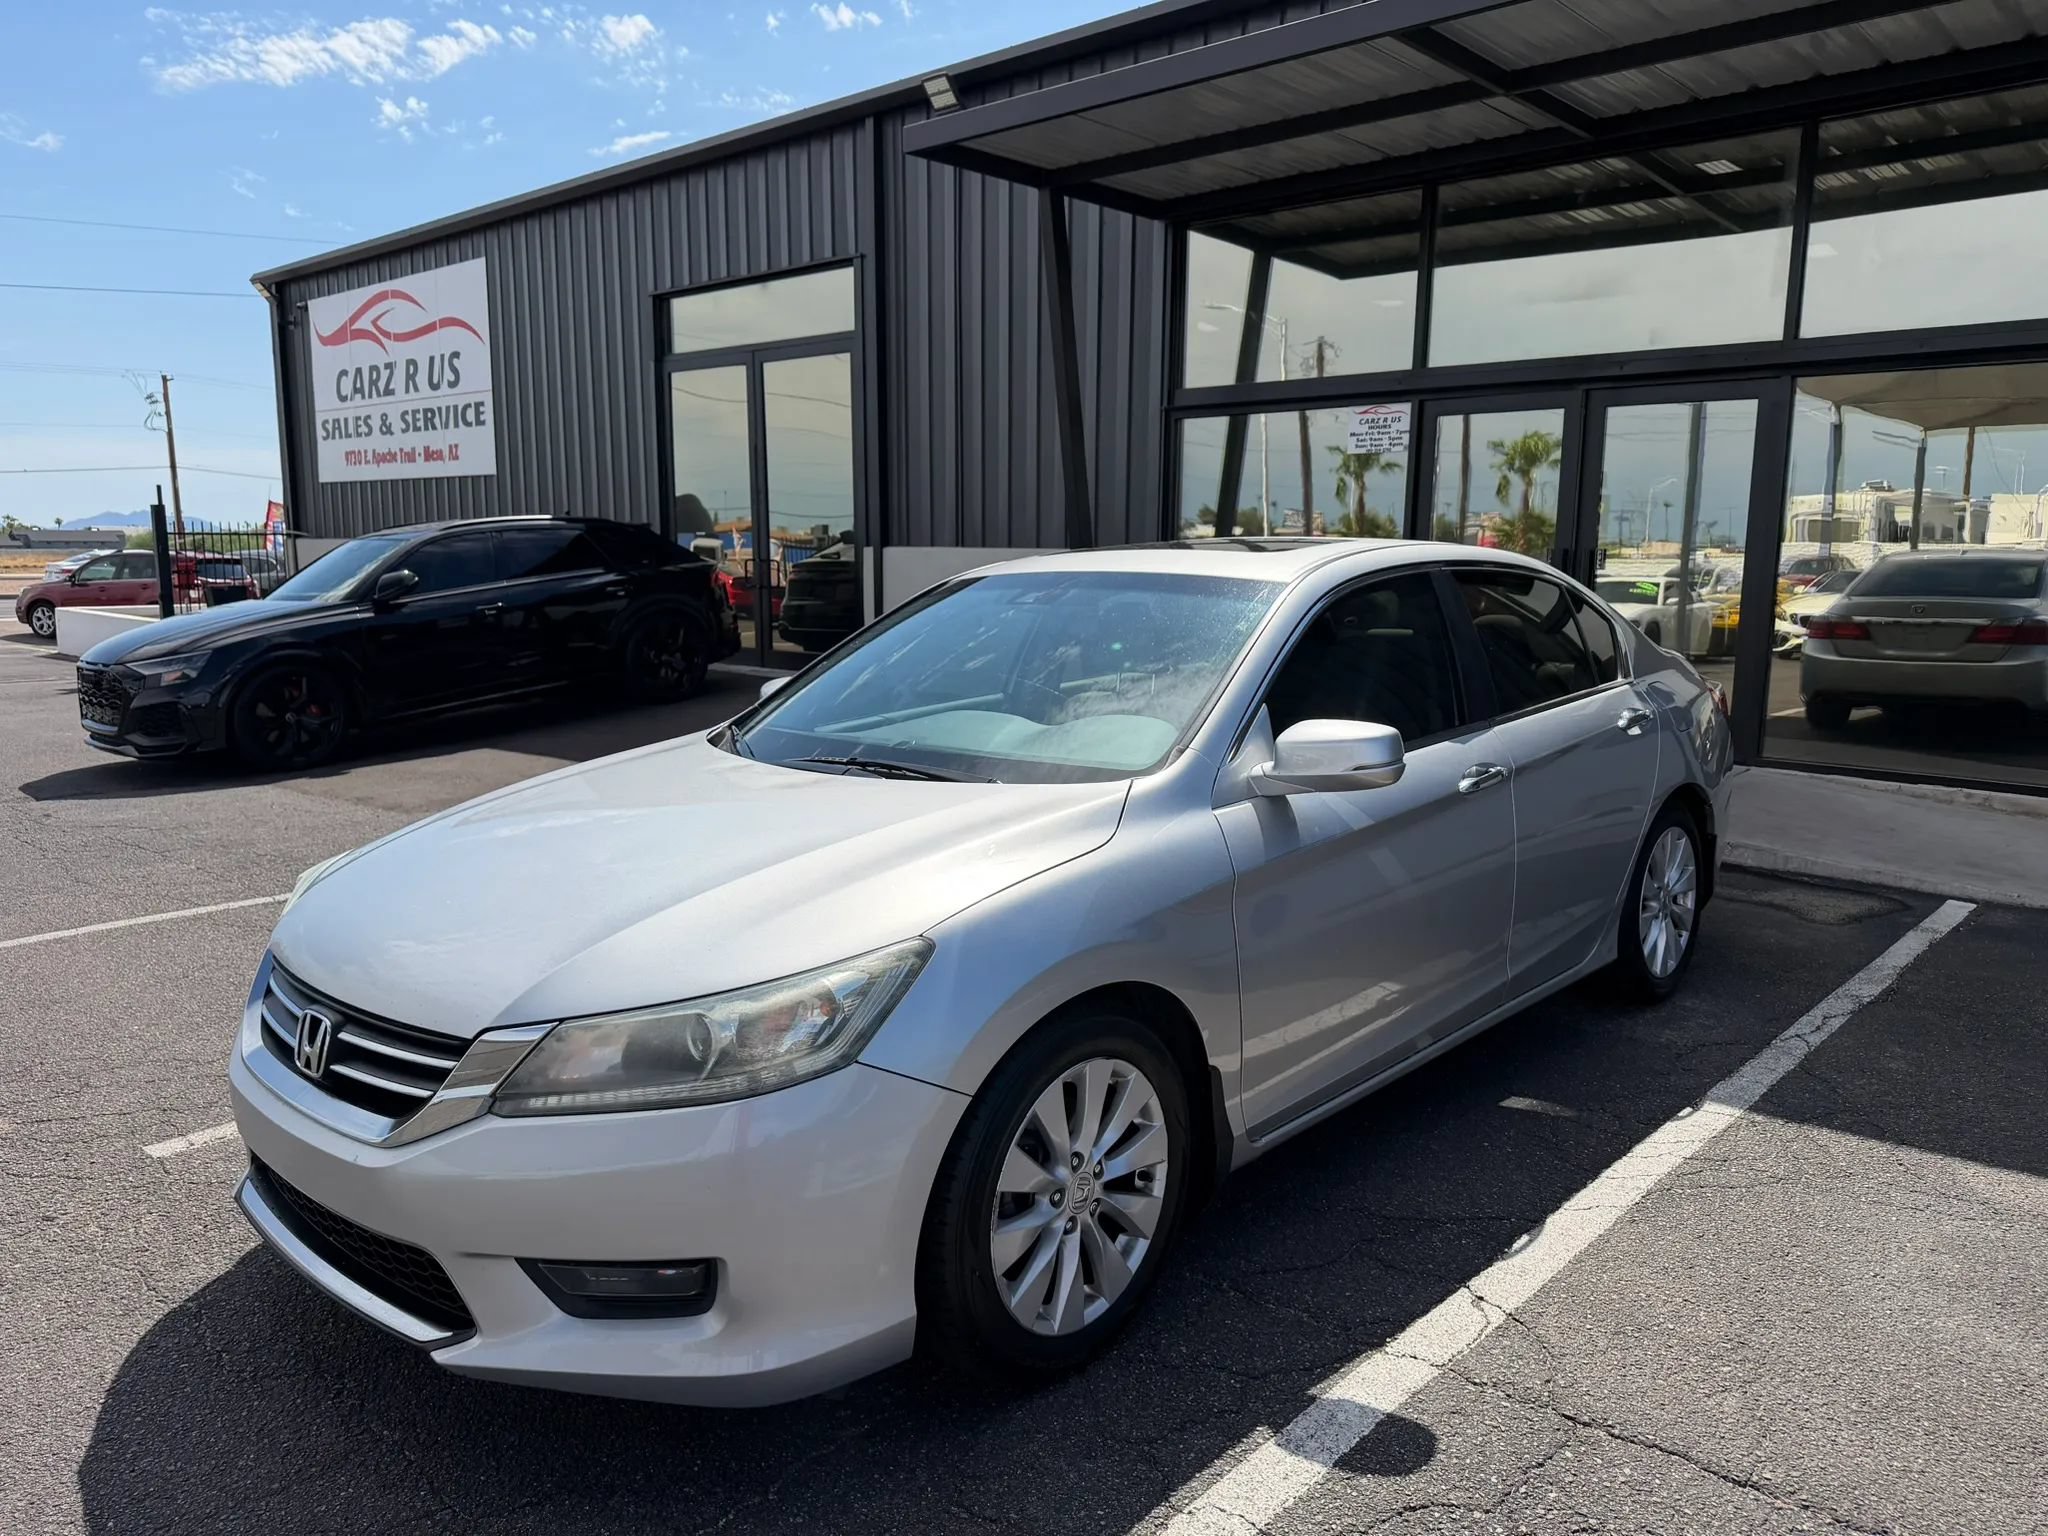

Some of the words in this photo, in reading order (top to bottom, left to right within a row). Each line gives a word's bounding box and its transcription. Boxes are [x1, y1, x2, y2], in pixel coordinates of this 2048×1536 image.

[336, 360, 397, 403] CARZ
[404, 358, 420, 394] R
[427, 350, 462, 392] US
[320, 413, 374, 441] SALES
[379, 412, 395, 437] &
[400, 401, 487, 434] SERVICE
[1359, 417, 1381, 425] CARZ
[371, 447, 398, 468] Apache
[399, 446, 417, 464] Trail
[448, 443, 460, 462] AZ
